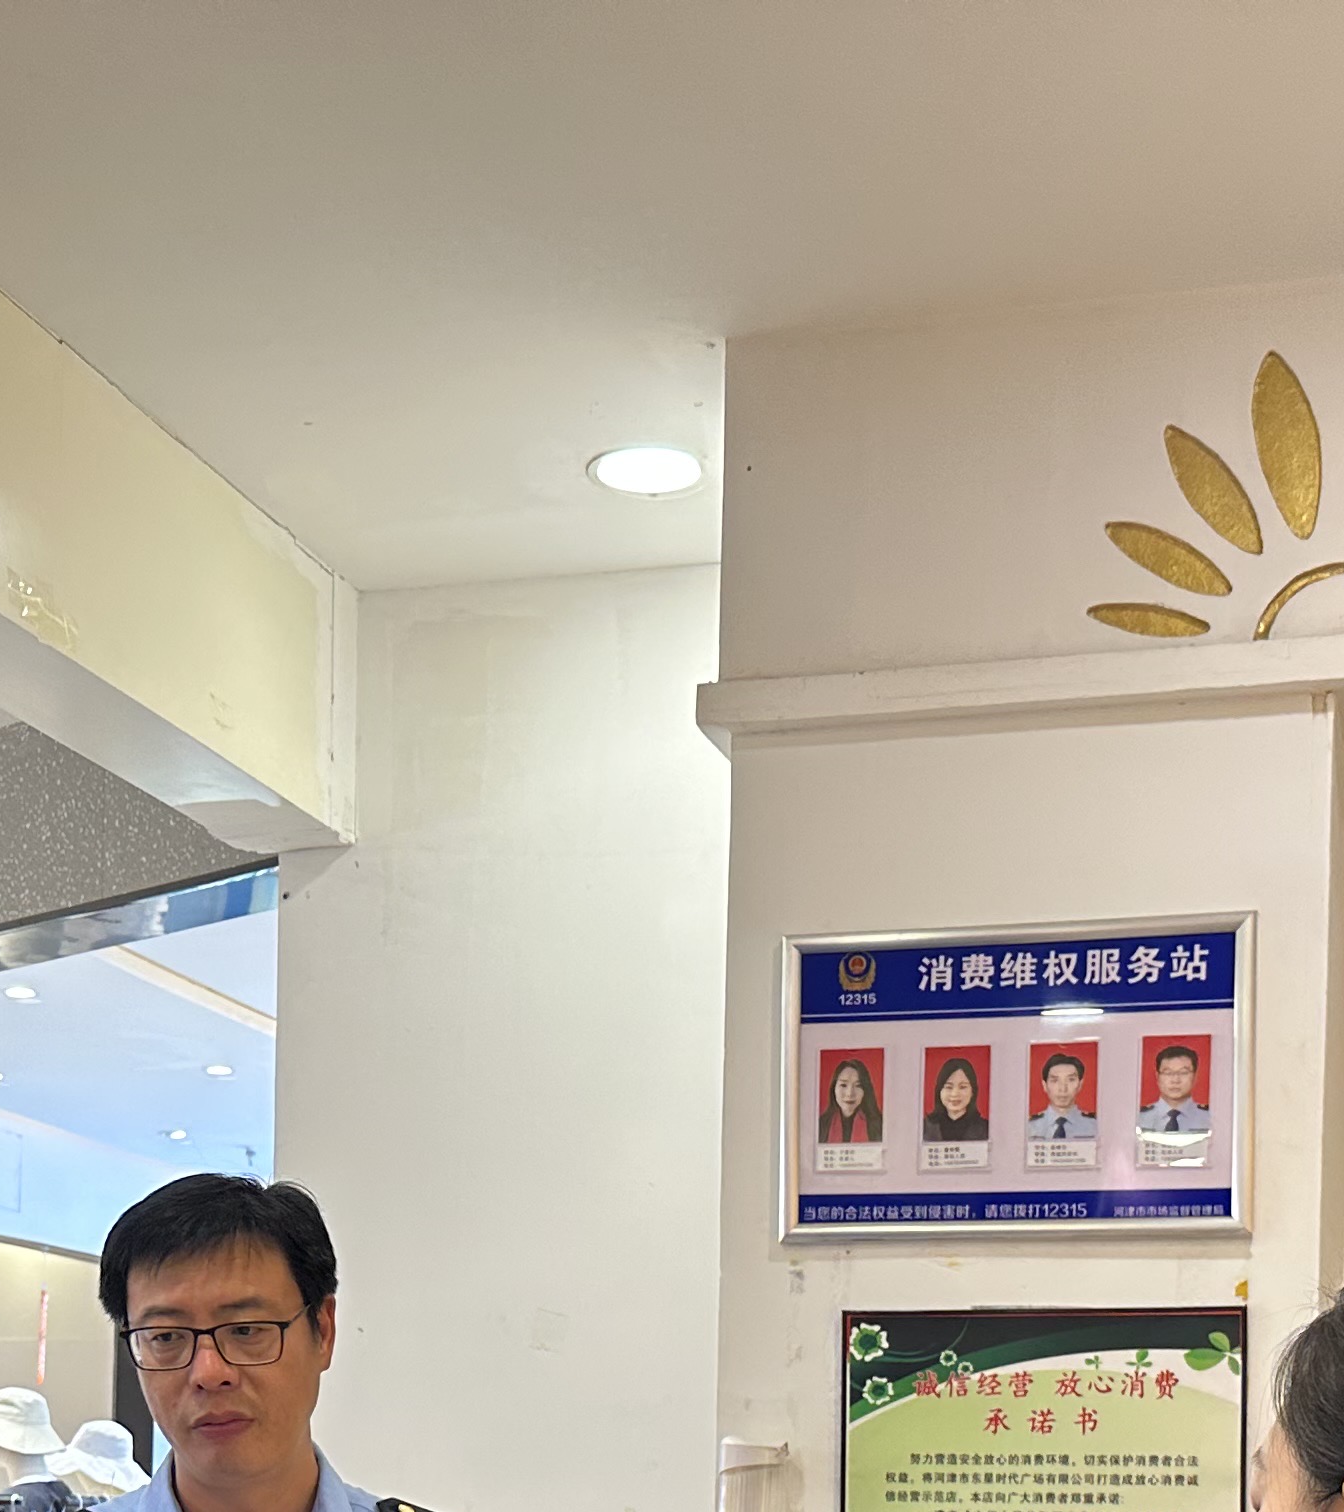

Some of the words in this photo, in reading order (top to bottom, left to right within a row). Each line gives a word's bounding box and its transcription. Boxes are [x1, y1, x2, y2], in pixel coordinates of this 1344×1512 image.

[918, 944, 1211, 992] 消费维权服务站
[838, 992, 878, 1006] 12315
[913, 1369, 1035, 1399] 诚信经营
[1056, 1369, 1180, 1400] 放心消费
[983, 1406, 1100, 1435] 承诺书
